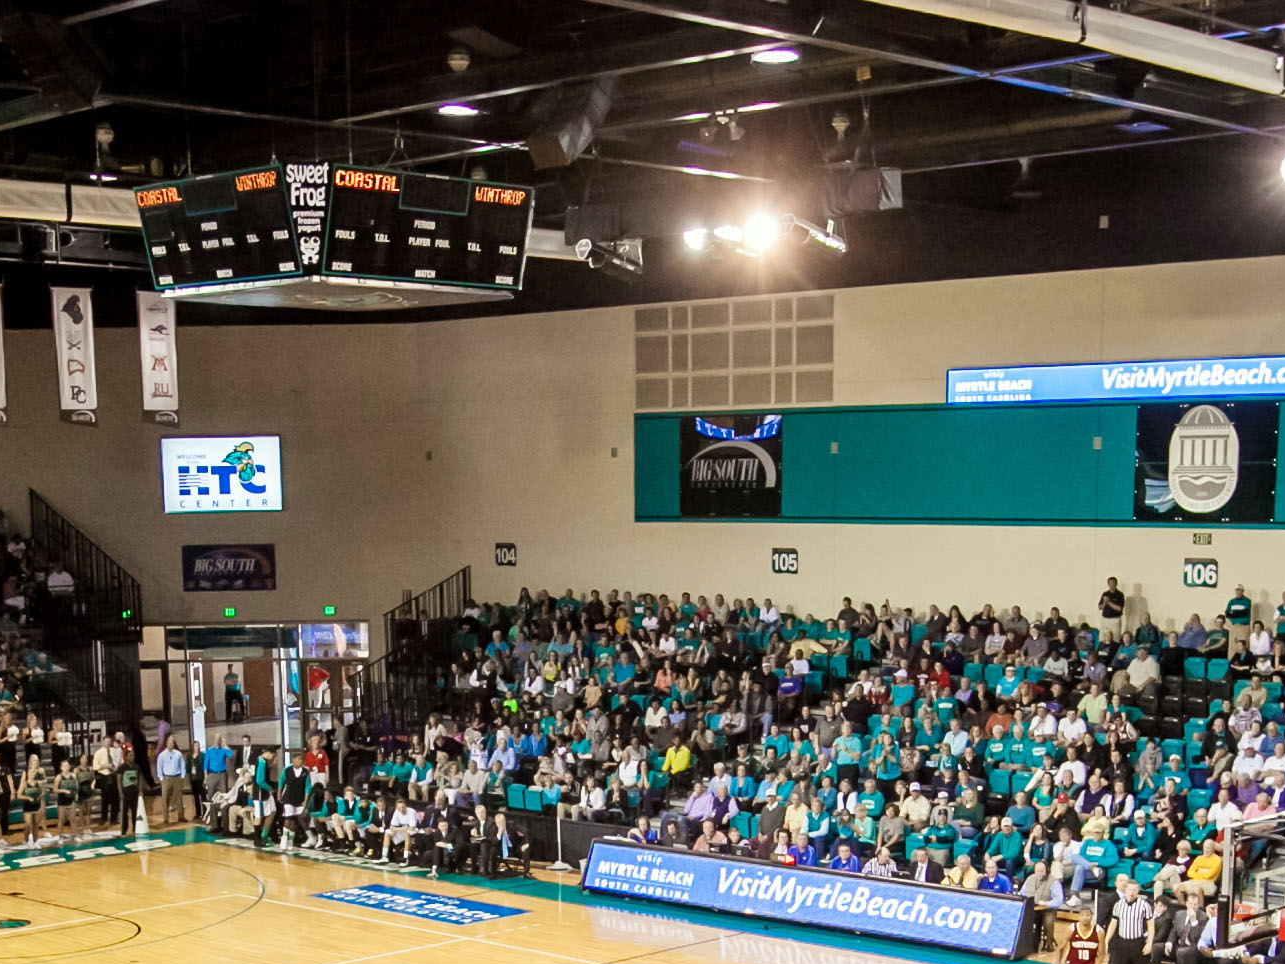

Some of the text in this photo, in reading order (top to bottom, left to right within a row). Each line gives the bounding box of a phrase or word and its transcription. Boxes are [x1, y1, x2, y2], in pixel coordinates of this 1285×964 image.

[235, 171, 277, 192] WINTHROP
[286, 162, 330, 183] sweet
[334, 169, 400, 193] COASTAL
[137, 187, 182, 207] COASTAL
[290, 183, 326, 207] Frog
[475, 186, 525, 205] WINTHROP
[335, 229, 356, 240] FOULS
[408, 237, 450, 249] PLAYER FOUL
[955, 379, 1032, 393] MYRTLE BEACH
[690, 458, 759, 482] BIG SOUTH
[178, 465, 267, 496] HTC
[179, 499, 269, 509] CENTER
[194, 557, 255, 573] BIG SOUTH
[496, 548, 516, 564] 104
[773, 553, 797, 572] 105
[1184, 563, 1218, 584] 106
[636, 852, 662, 865] visit
[597, 860, 695, 888] MYRTLE BEACH
[594, 879, 689, 901] SOUTH CAROLINA
[716, 866, 993, 934] VisitMyrtleBeach.com
[341, 888, 501, 920] MYRTLE BEACH
[1078, 949, 1090, 960] 10
